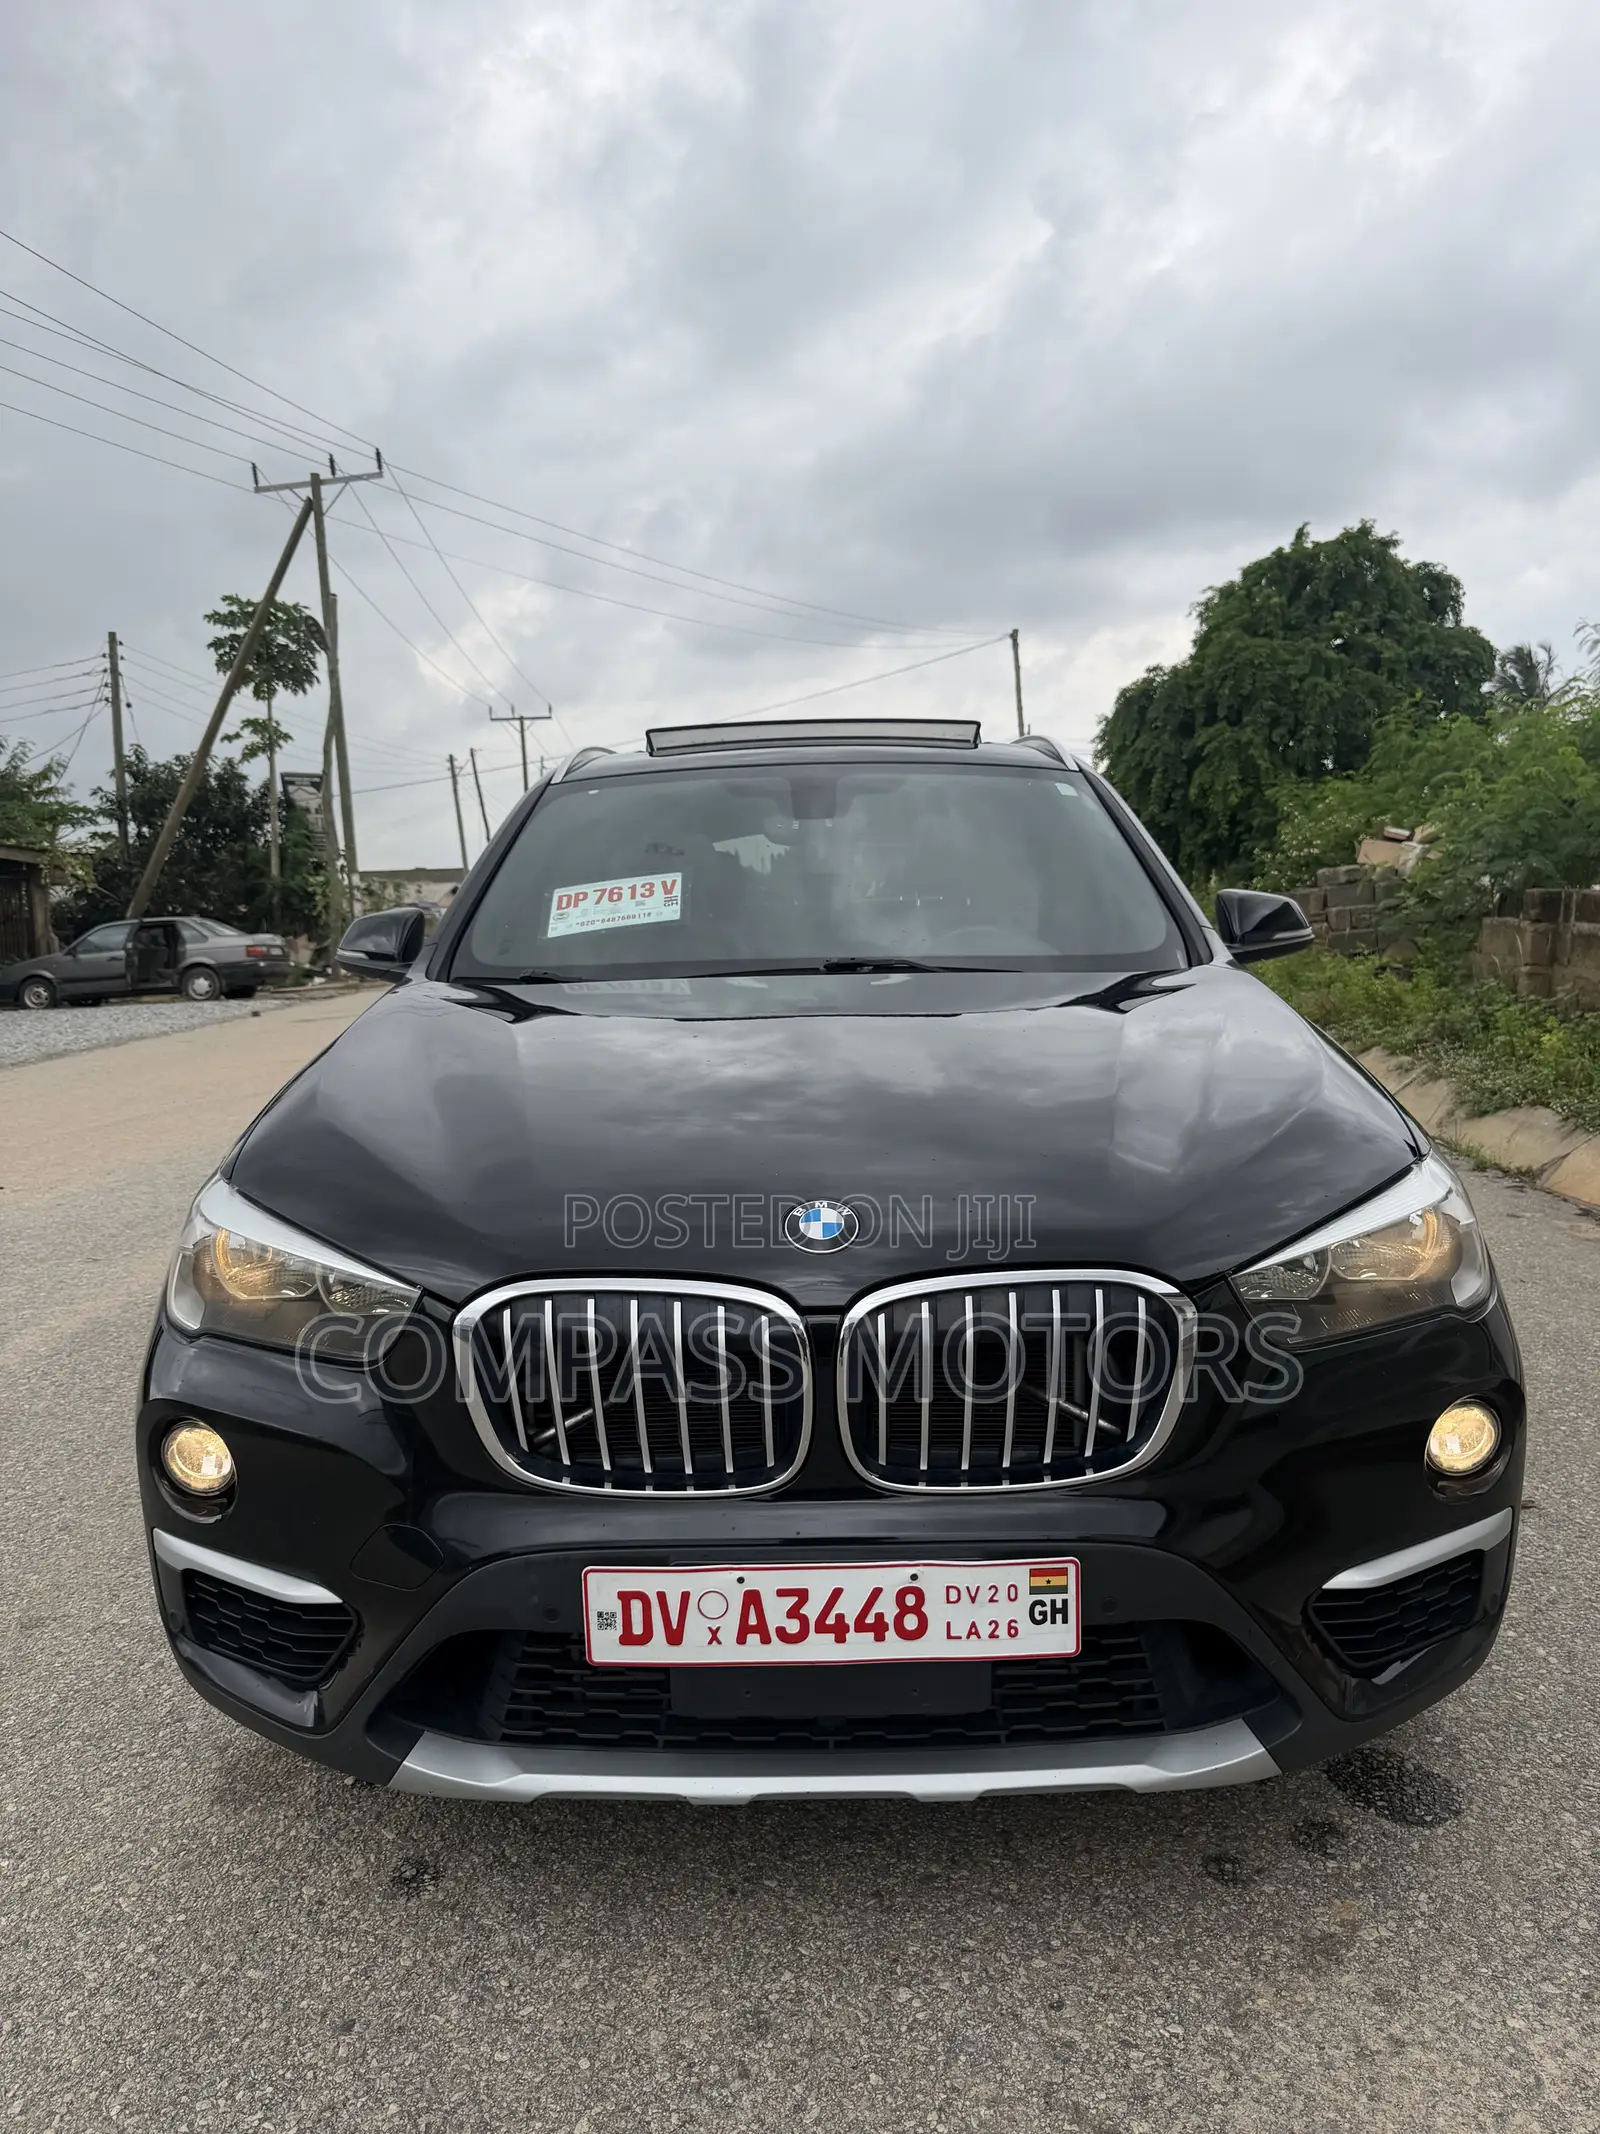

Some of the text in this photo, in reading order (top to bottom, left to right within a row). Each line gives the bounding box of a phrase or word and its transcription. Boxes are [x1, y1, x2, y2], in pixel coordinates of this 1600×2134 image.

[556, 891, 588, 911] DP
[593, 882, 655, 905] 7613
[661, 879, 677, 896] V
[793, 1202, 852, 1217] BMW
[616, 1588, 691, 1646] DV
[735, 1585, 928, 1645] A3448
[1028, 1598, 1068, 1625] GH
